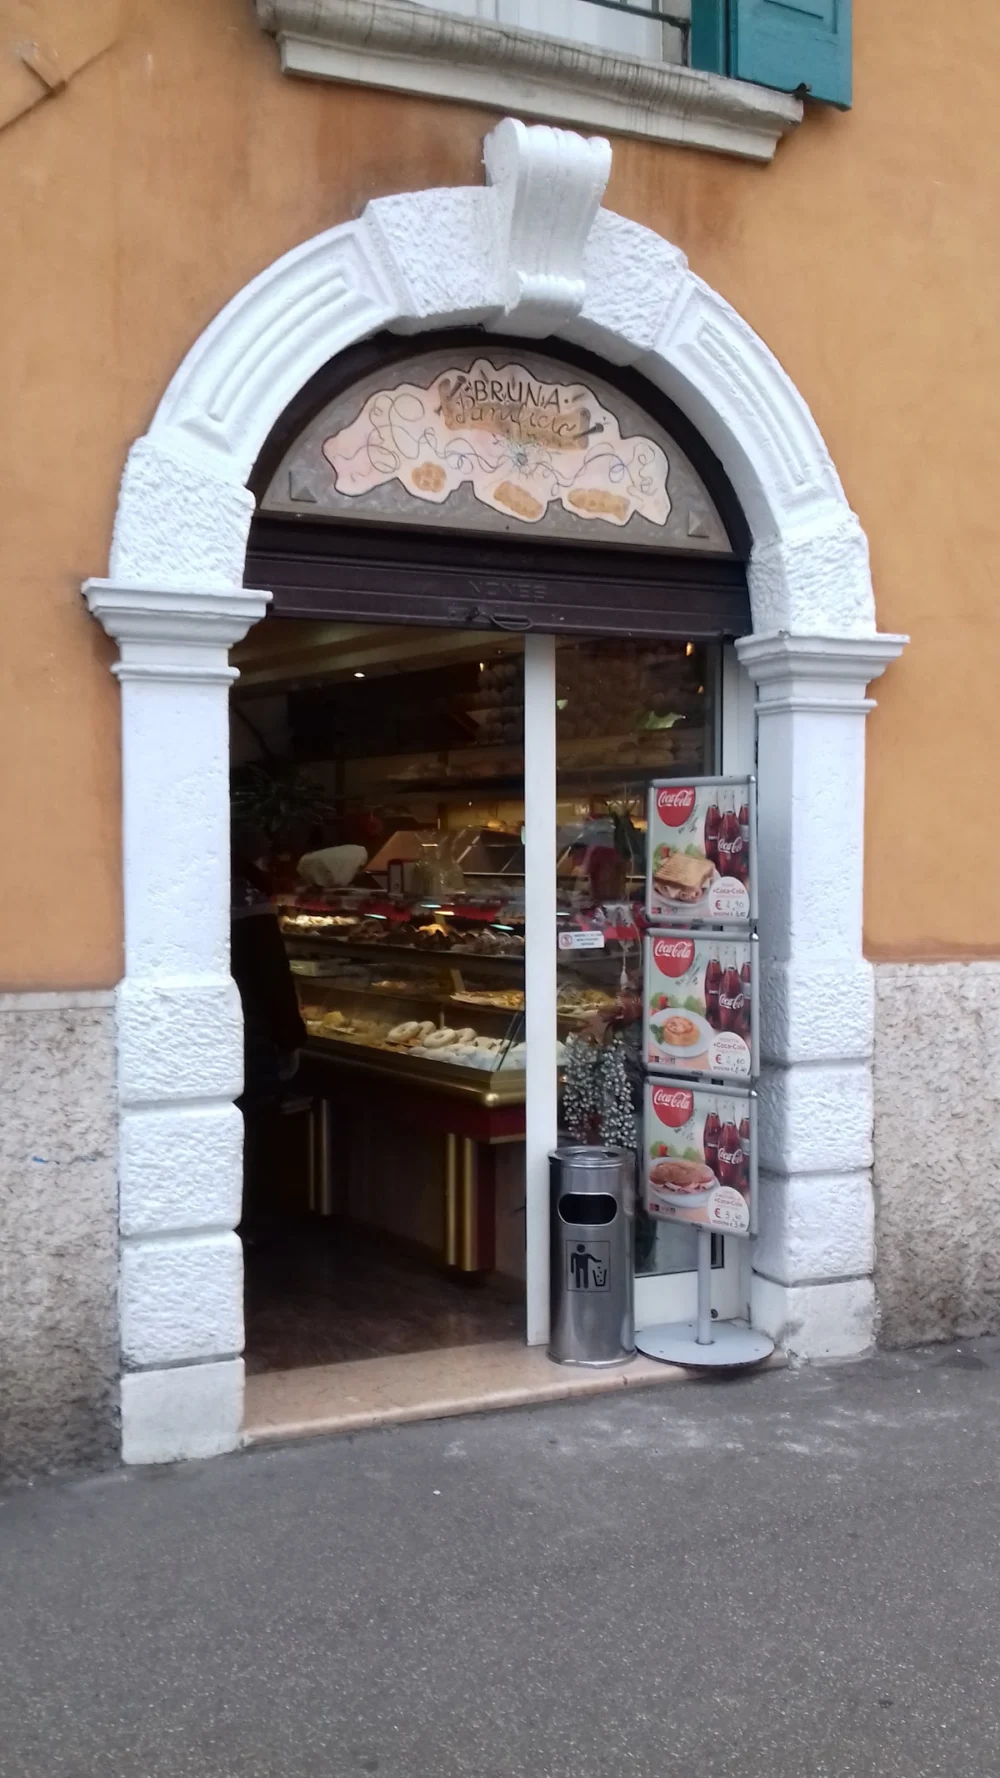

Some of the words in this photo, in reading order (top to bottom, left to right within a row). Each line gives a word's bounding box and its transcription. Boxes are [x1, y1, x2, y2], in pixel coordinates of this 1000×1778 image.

[657, 789, 694, 808] Coca-Cola
[654, 940, 692, 958] Coca-Cola
[653, 1089, 693, 1109] Coca-Cola
